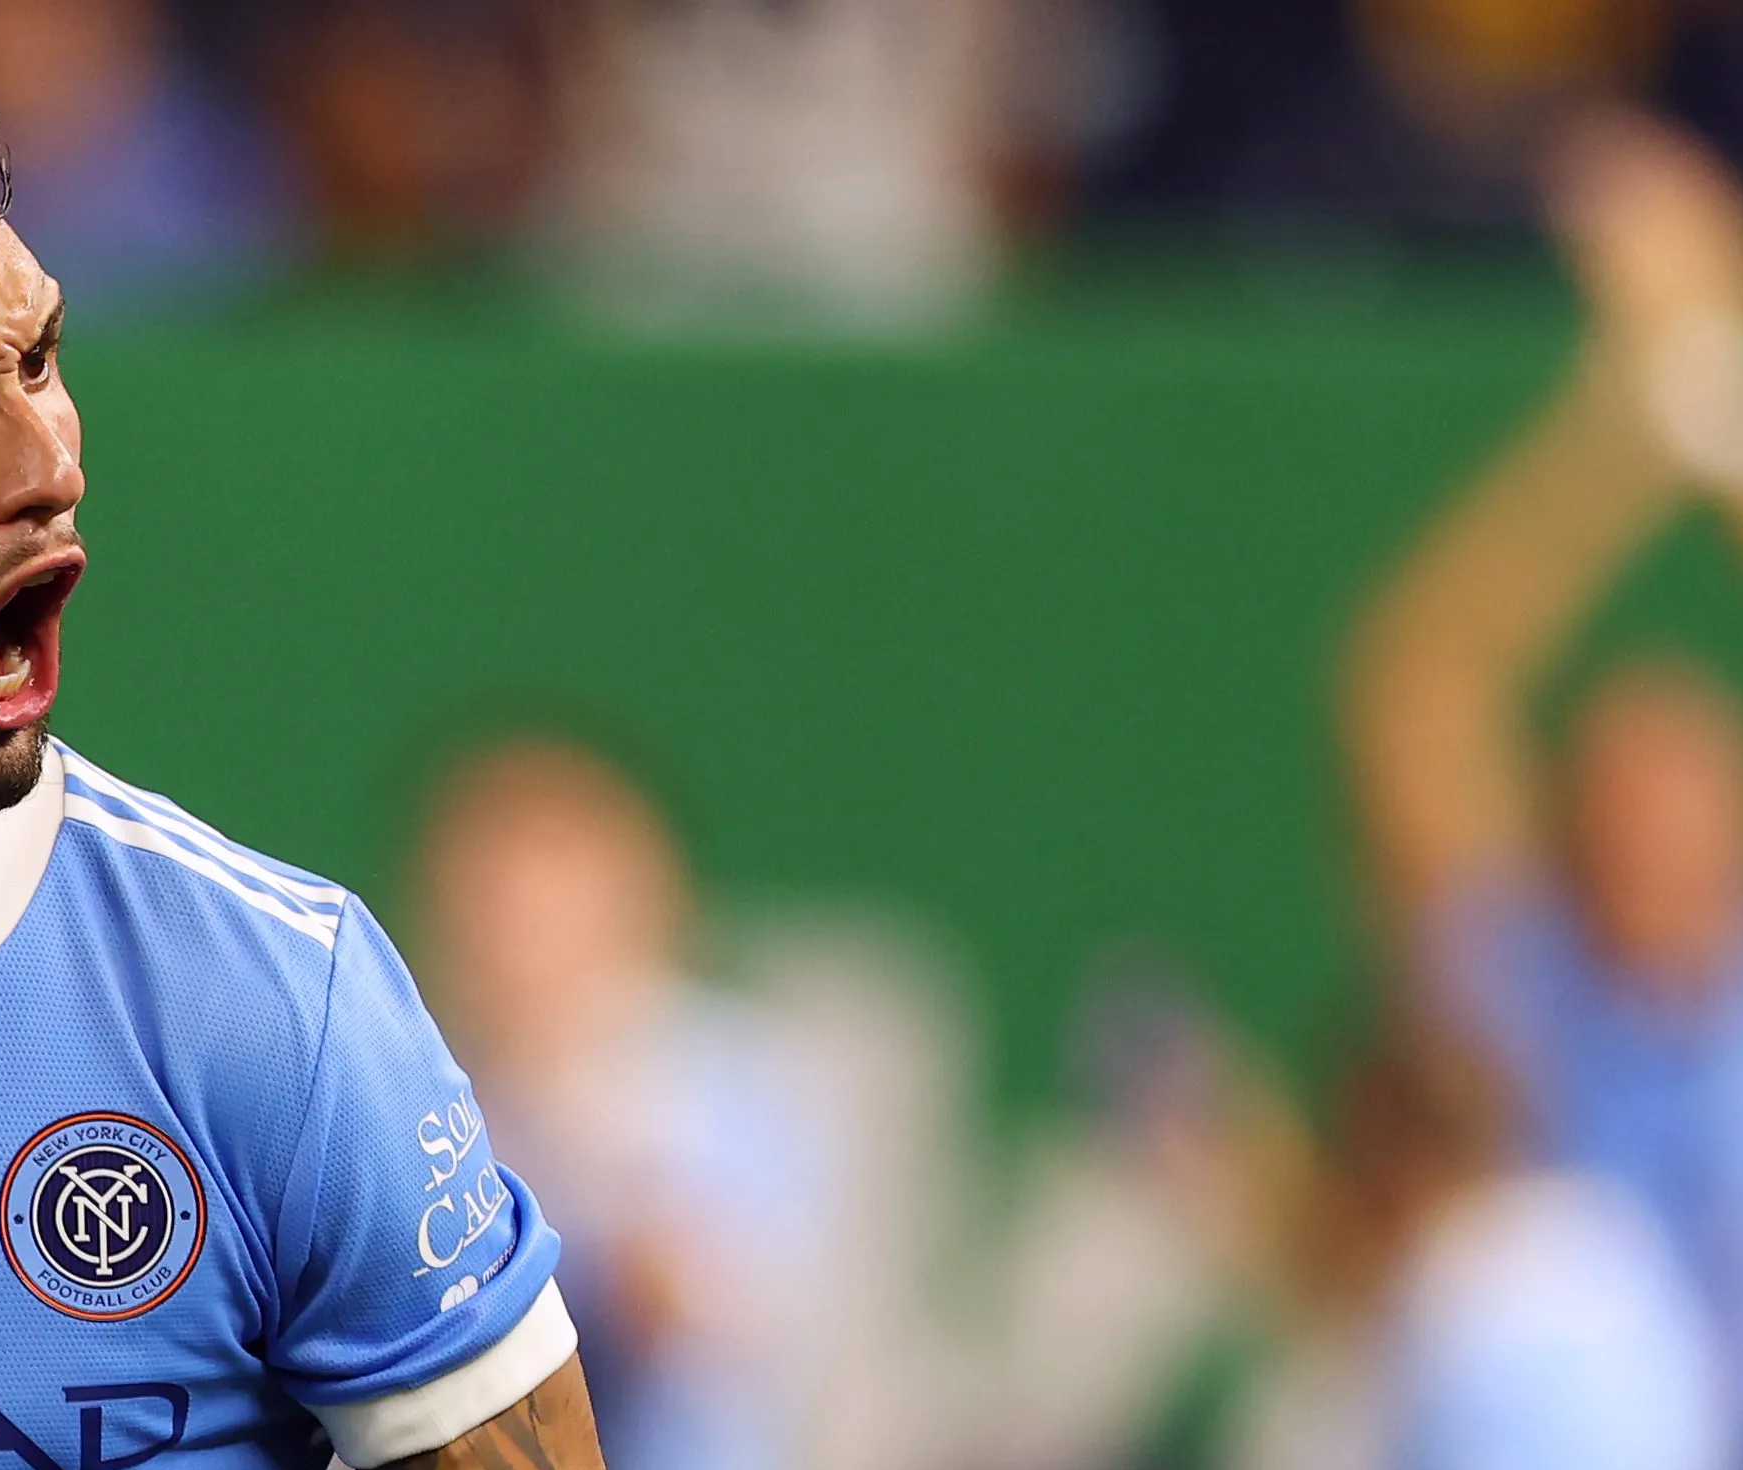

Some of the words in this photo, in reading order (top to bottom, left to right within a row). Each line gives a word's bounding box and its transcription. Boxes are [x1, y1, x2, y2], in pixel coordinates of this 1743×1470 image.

[32, 1134, 69, 1168] NEW
[74, 1126, 124, 1142] YORK
[129, 1133, 168, 1162] CITY
[37, 1269, 126, 1307] FOOTBALL
[131, 1265, 172, 1299] CLUB
